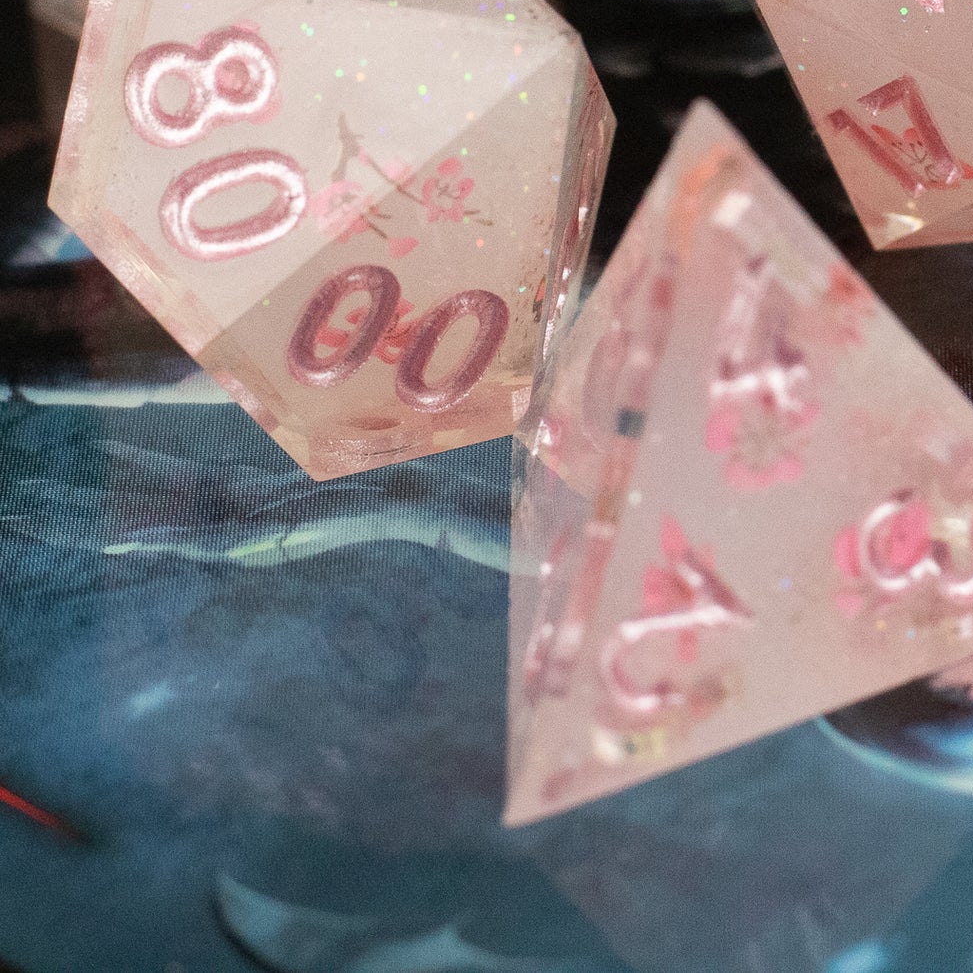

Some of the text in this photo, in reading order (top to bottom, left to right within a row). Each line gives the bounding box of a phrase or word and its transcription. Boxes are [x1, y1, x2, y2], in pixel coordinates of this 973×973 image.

[124, 27, 308, 261] 80
[825, 75, 962, 199] 17
[287, 264, 510, 414] 00
